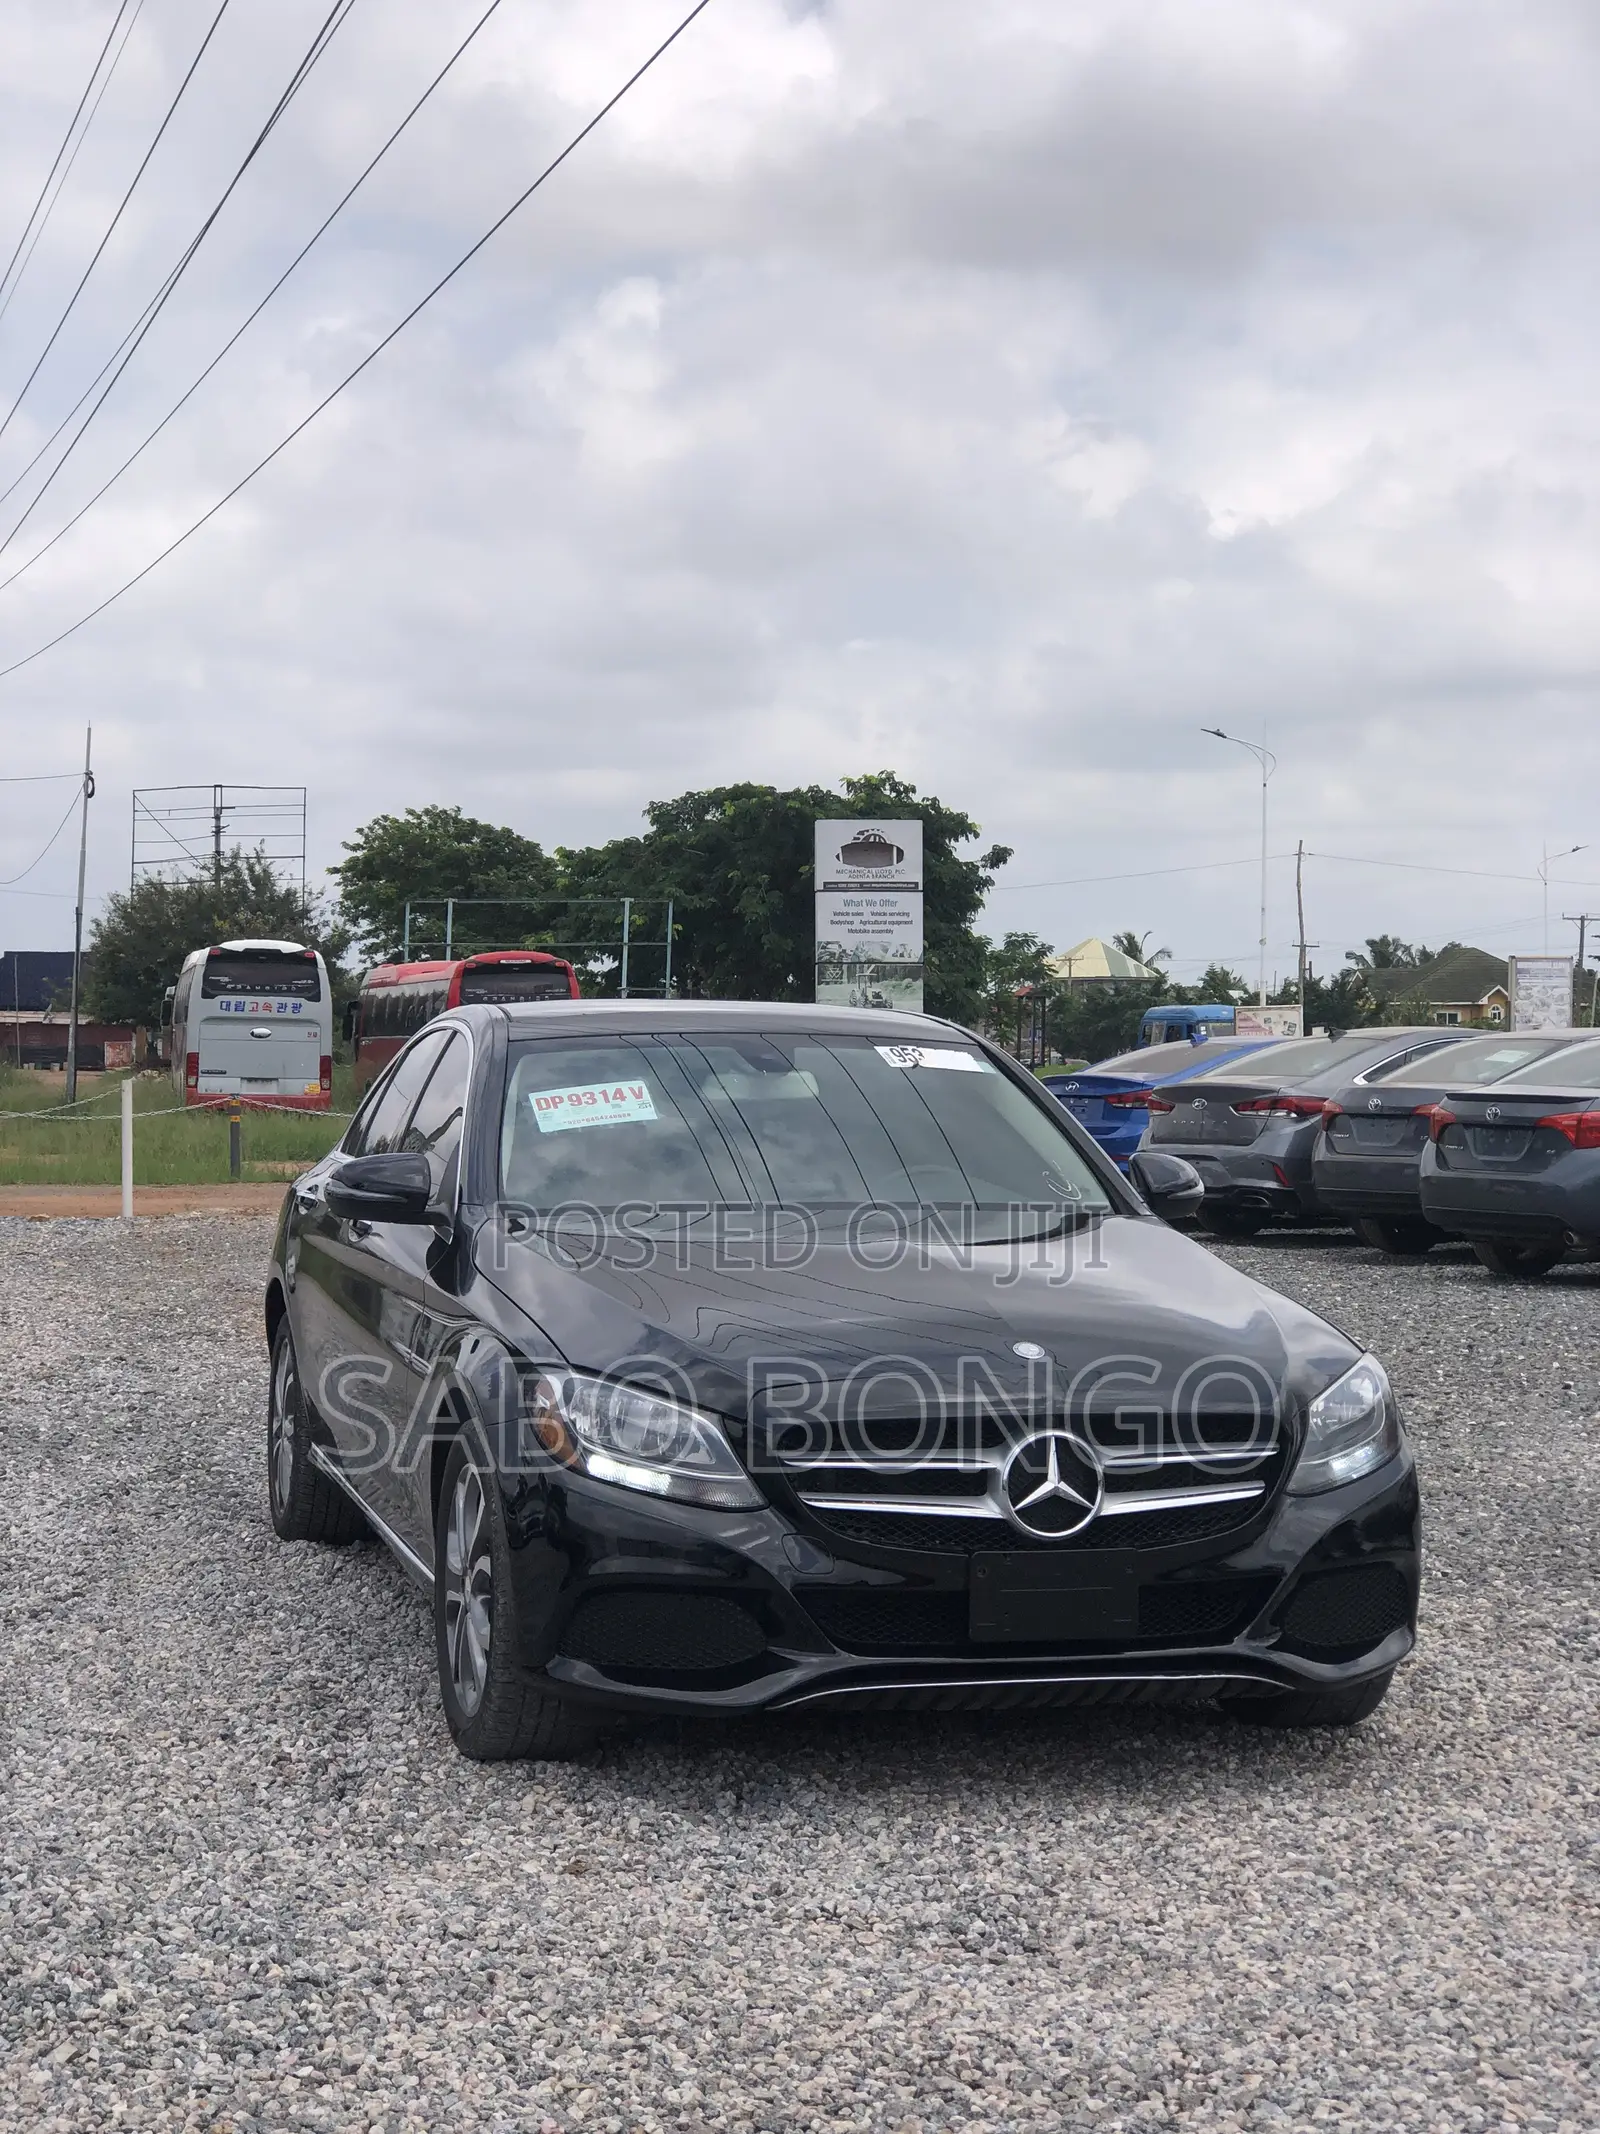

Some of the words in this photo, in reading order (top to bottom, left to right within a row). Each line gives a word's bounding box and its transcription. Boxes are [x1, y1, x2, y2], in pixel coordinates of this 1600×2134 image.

[843, 899, 863, 907] What
[865, 899, 877, 907] We
[879, 899, 898, 907] Offer
